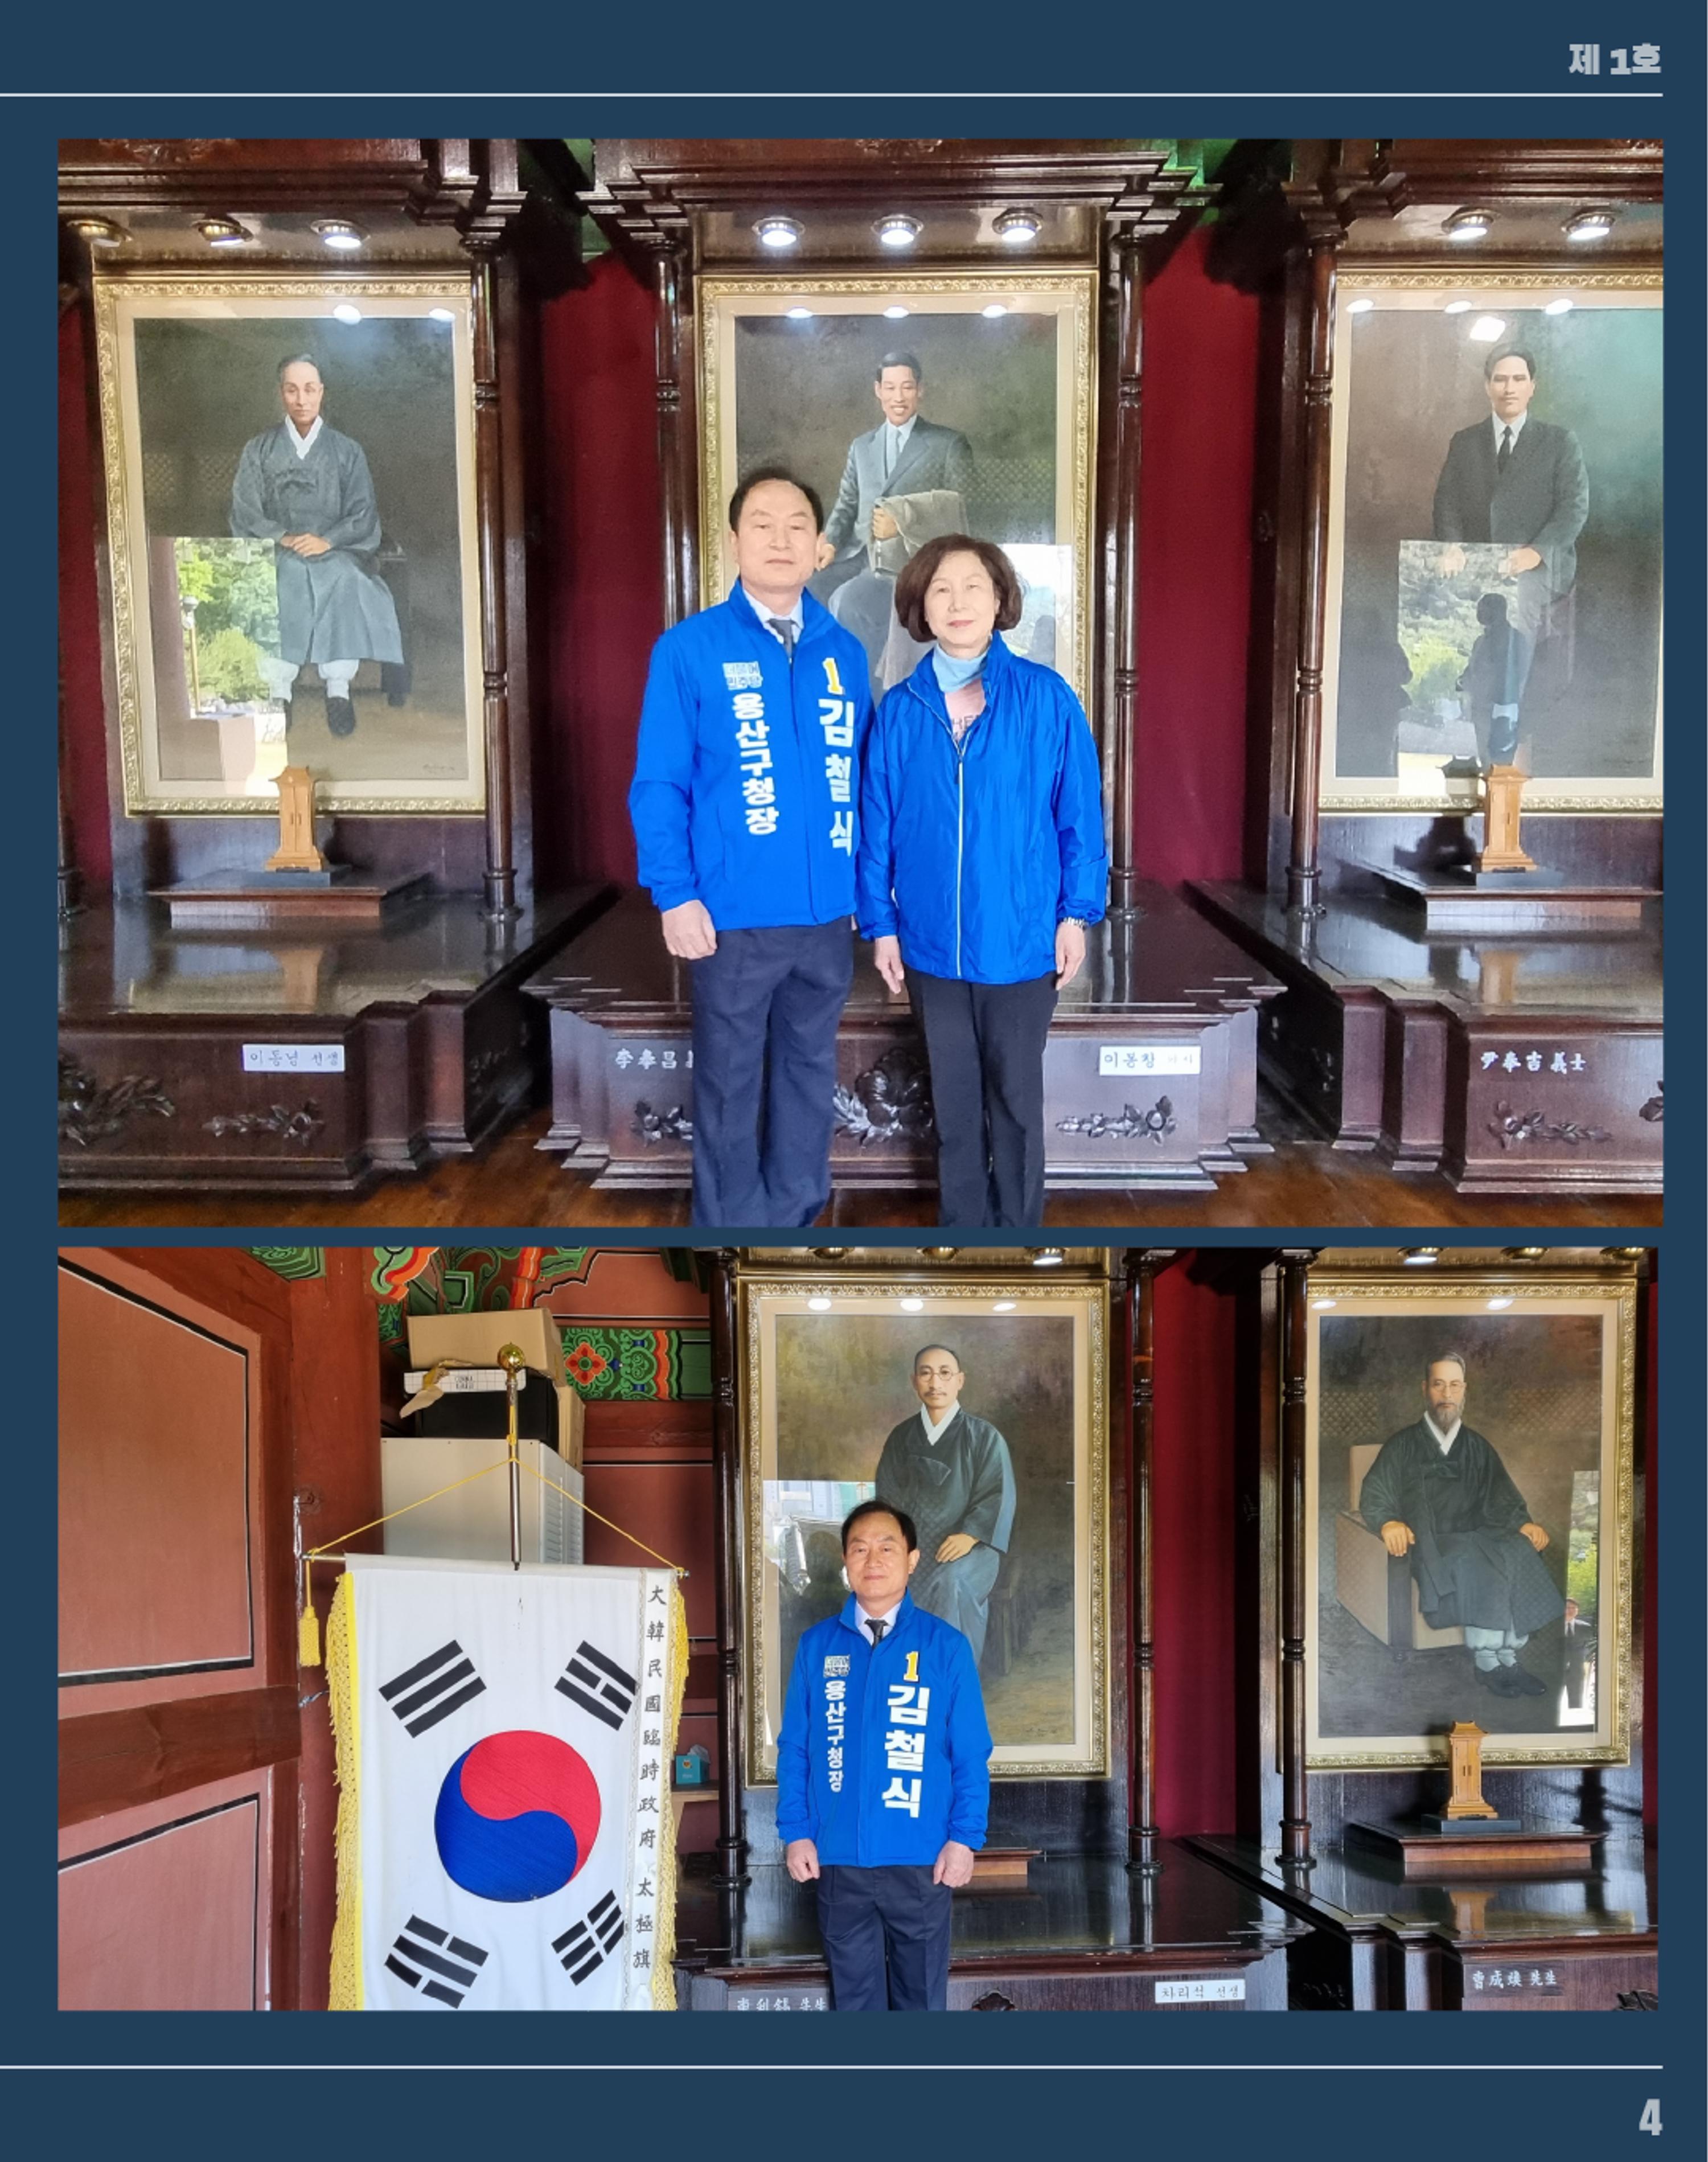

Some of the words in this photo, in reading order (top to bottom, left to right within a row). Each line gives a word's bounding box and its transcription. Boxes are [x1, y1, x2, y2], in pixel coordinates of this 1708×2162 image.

[823, 658, 845, 695] 1
[732, 692, 779, 835] 용산구청장
[818, 699, 854, 856] 김철식
[1105, 1052, 1155, 1068] 이봉창
[904, 1651, 919, 1681] 1
[825, 1680, 846, 1793] 용산구청장
[882, 1685, 930, 1818] 김철식
[1162, 1985, 1204, 1999] 차리석
[1217, 1985, 1238, 1998] 선생
